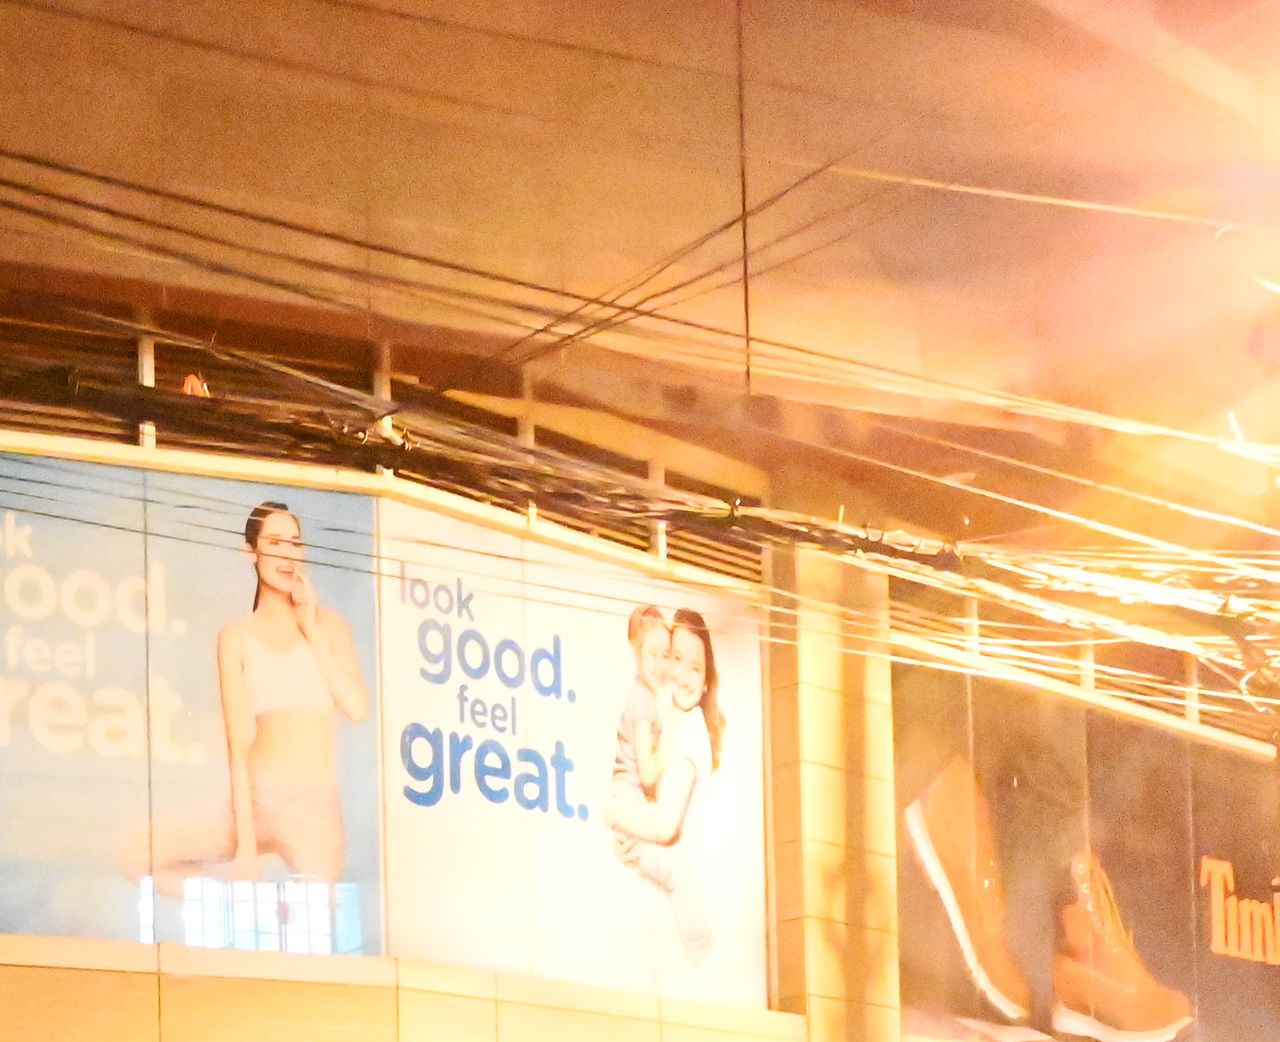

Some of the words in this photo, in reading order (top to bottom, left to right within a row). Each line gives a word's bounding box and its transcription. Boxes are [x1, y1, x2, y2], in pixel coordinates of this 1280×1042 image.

[399, 560, 475, 622] look
[417, 617, 577, 703] good.
[456, 684, 517, 736] feel
[399, 722, 590, 821] great.
